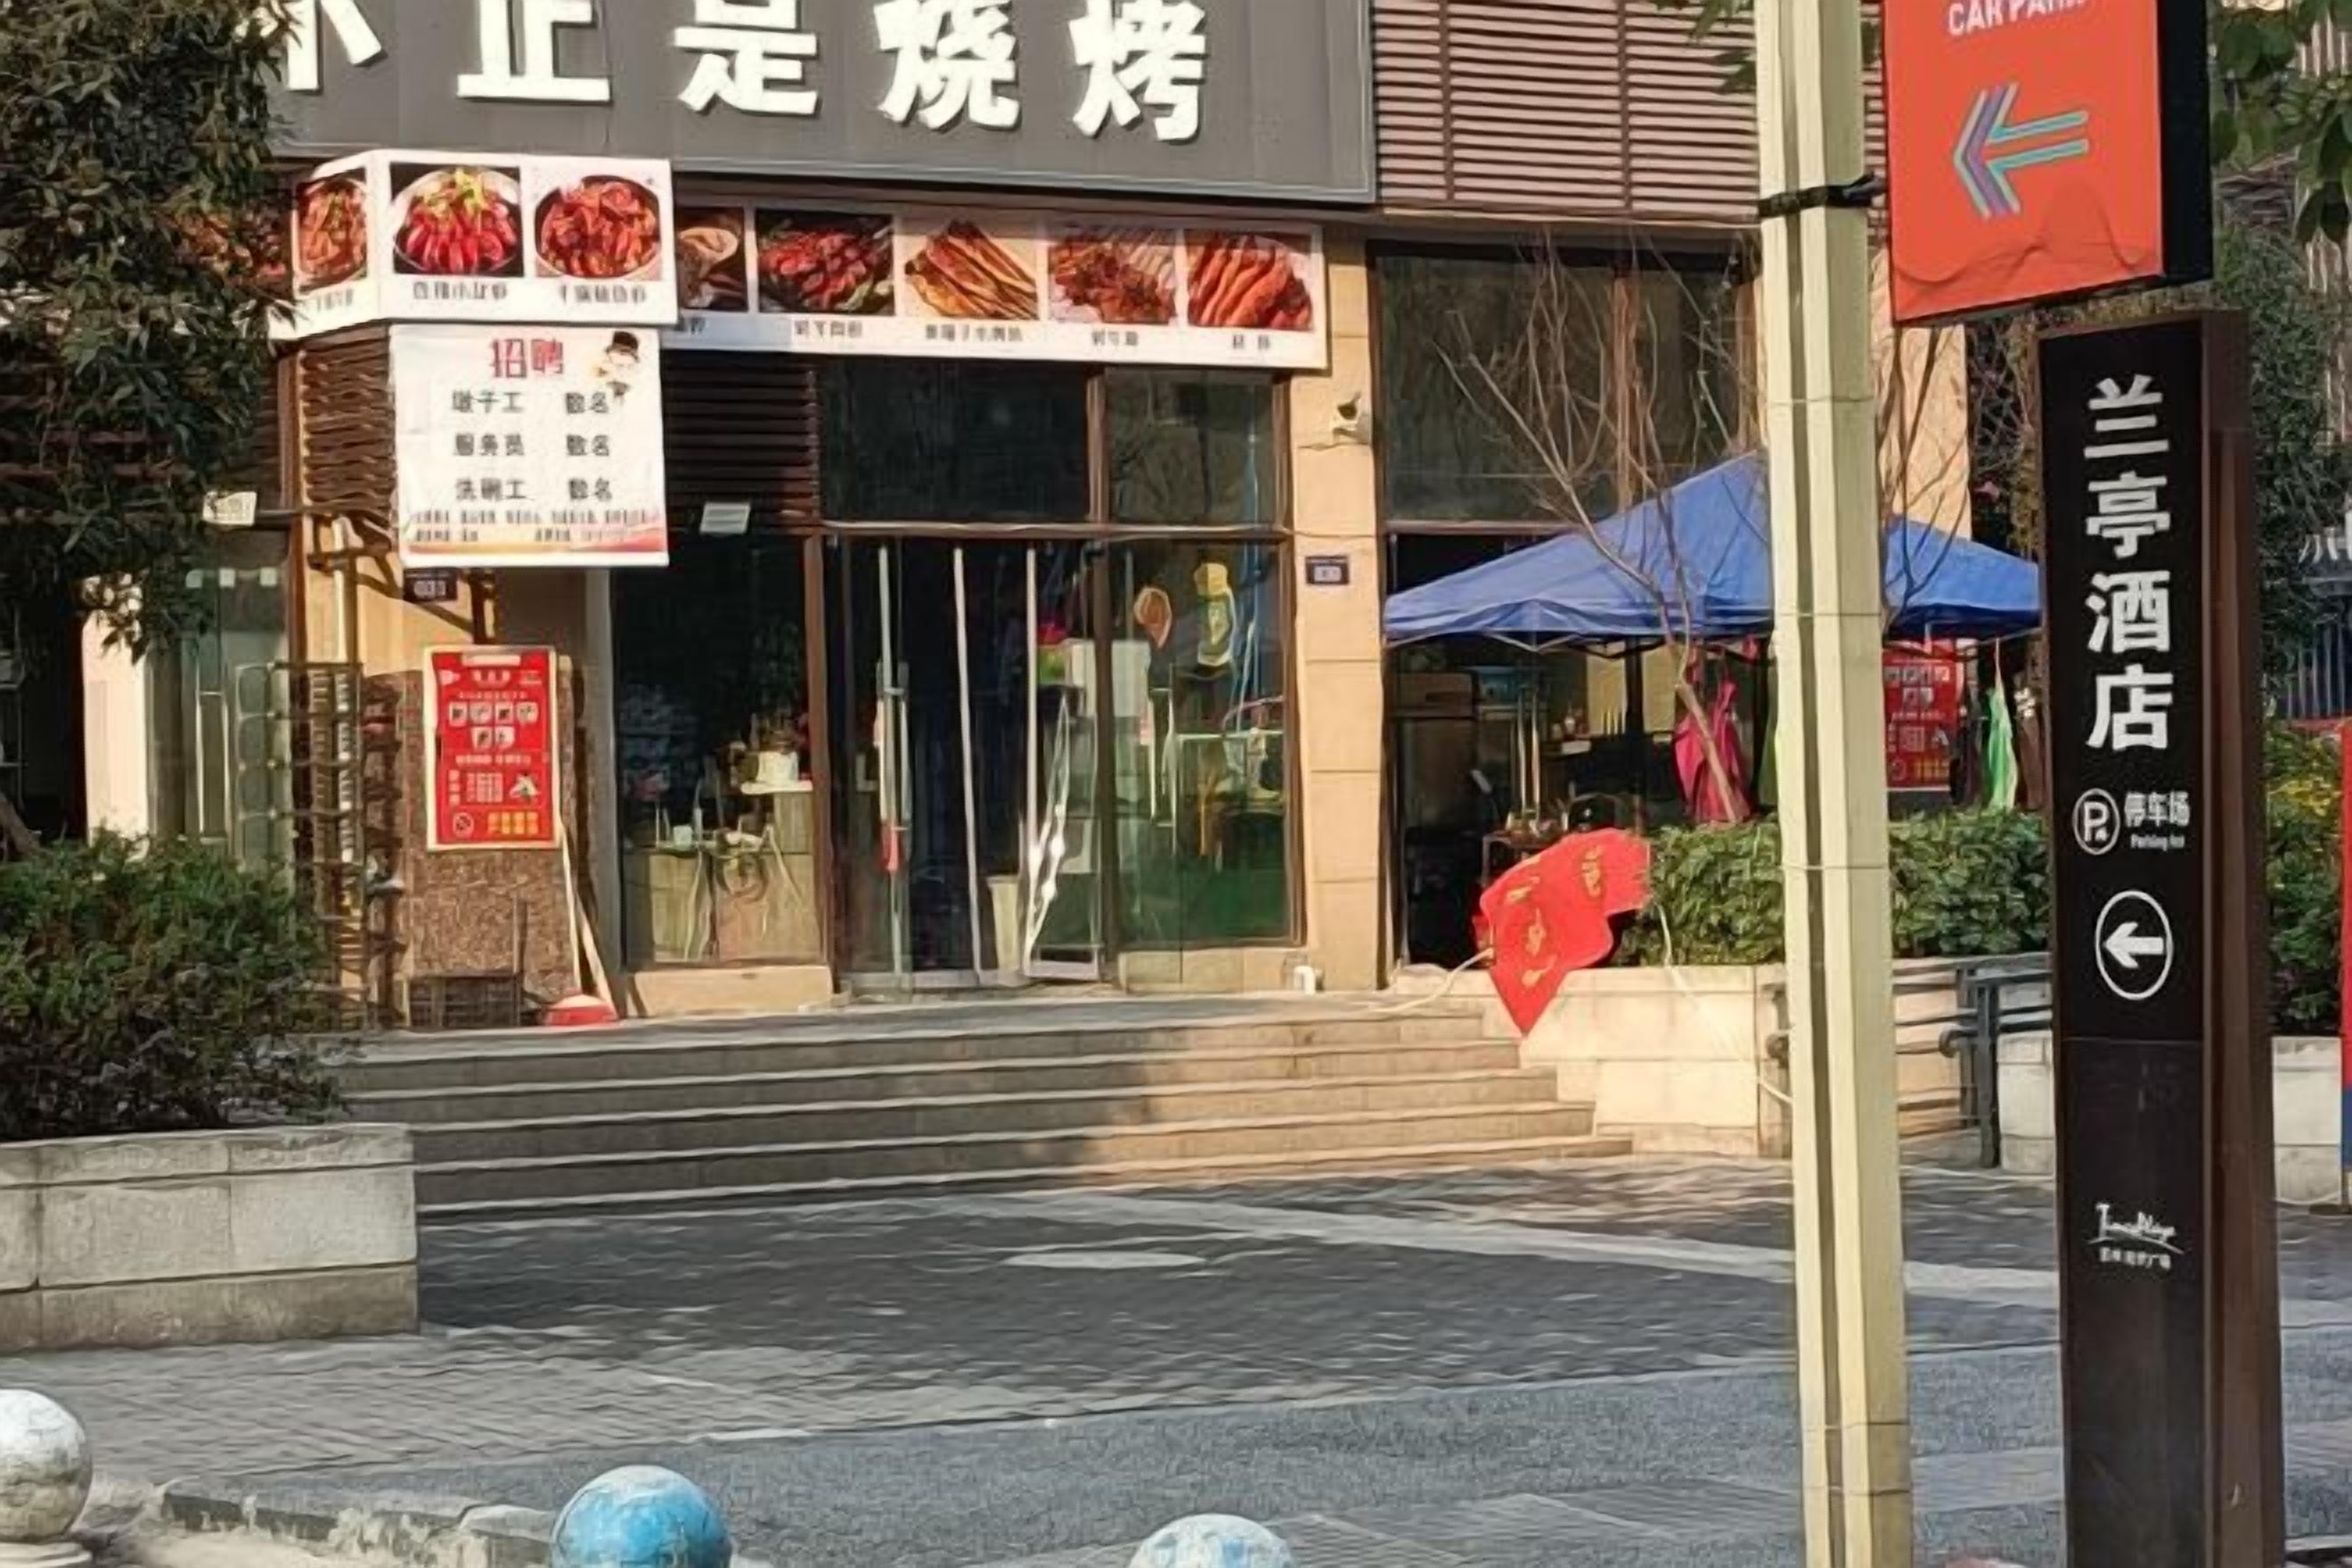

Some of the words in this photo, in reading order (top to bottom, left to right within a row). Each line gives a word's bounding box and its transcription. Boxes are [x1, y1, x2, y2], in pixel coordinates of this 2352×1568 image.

[1948, 0, 2005, 36] CAR
[2008, 0, 2085, 22] PA
[488, 338, 564, 379] 招聘
[2083, 373, 2175, 752] 兰亭酒店
